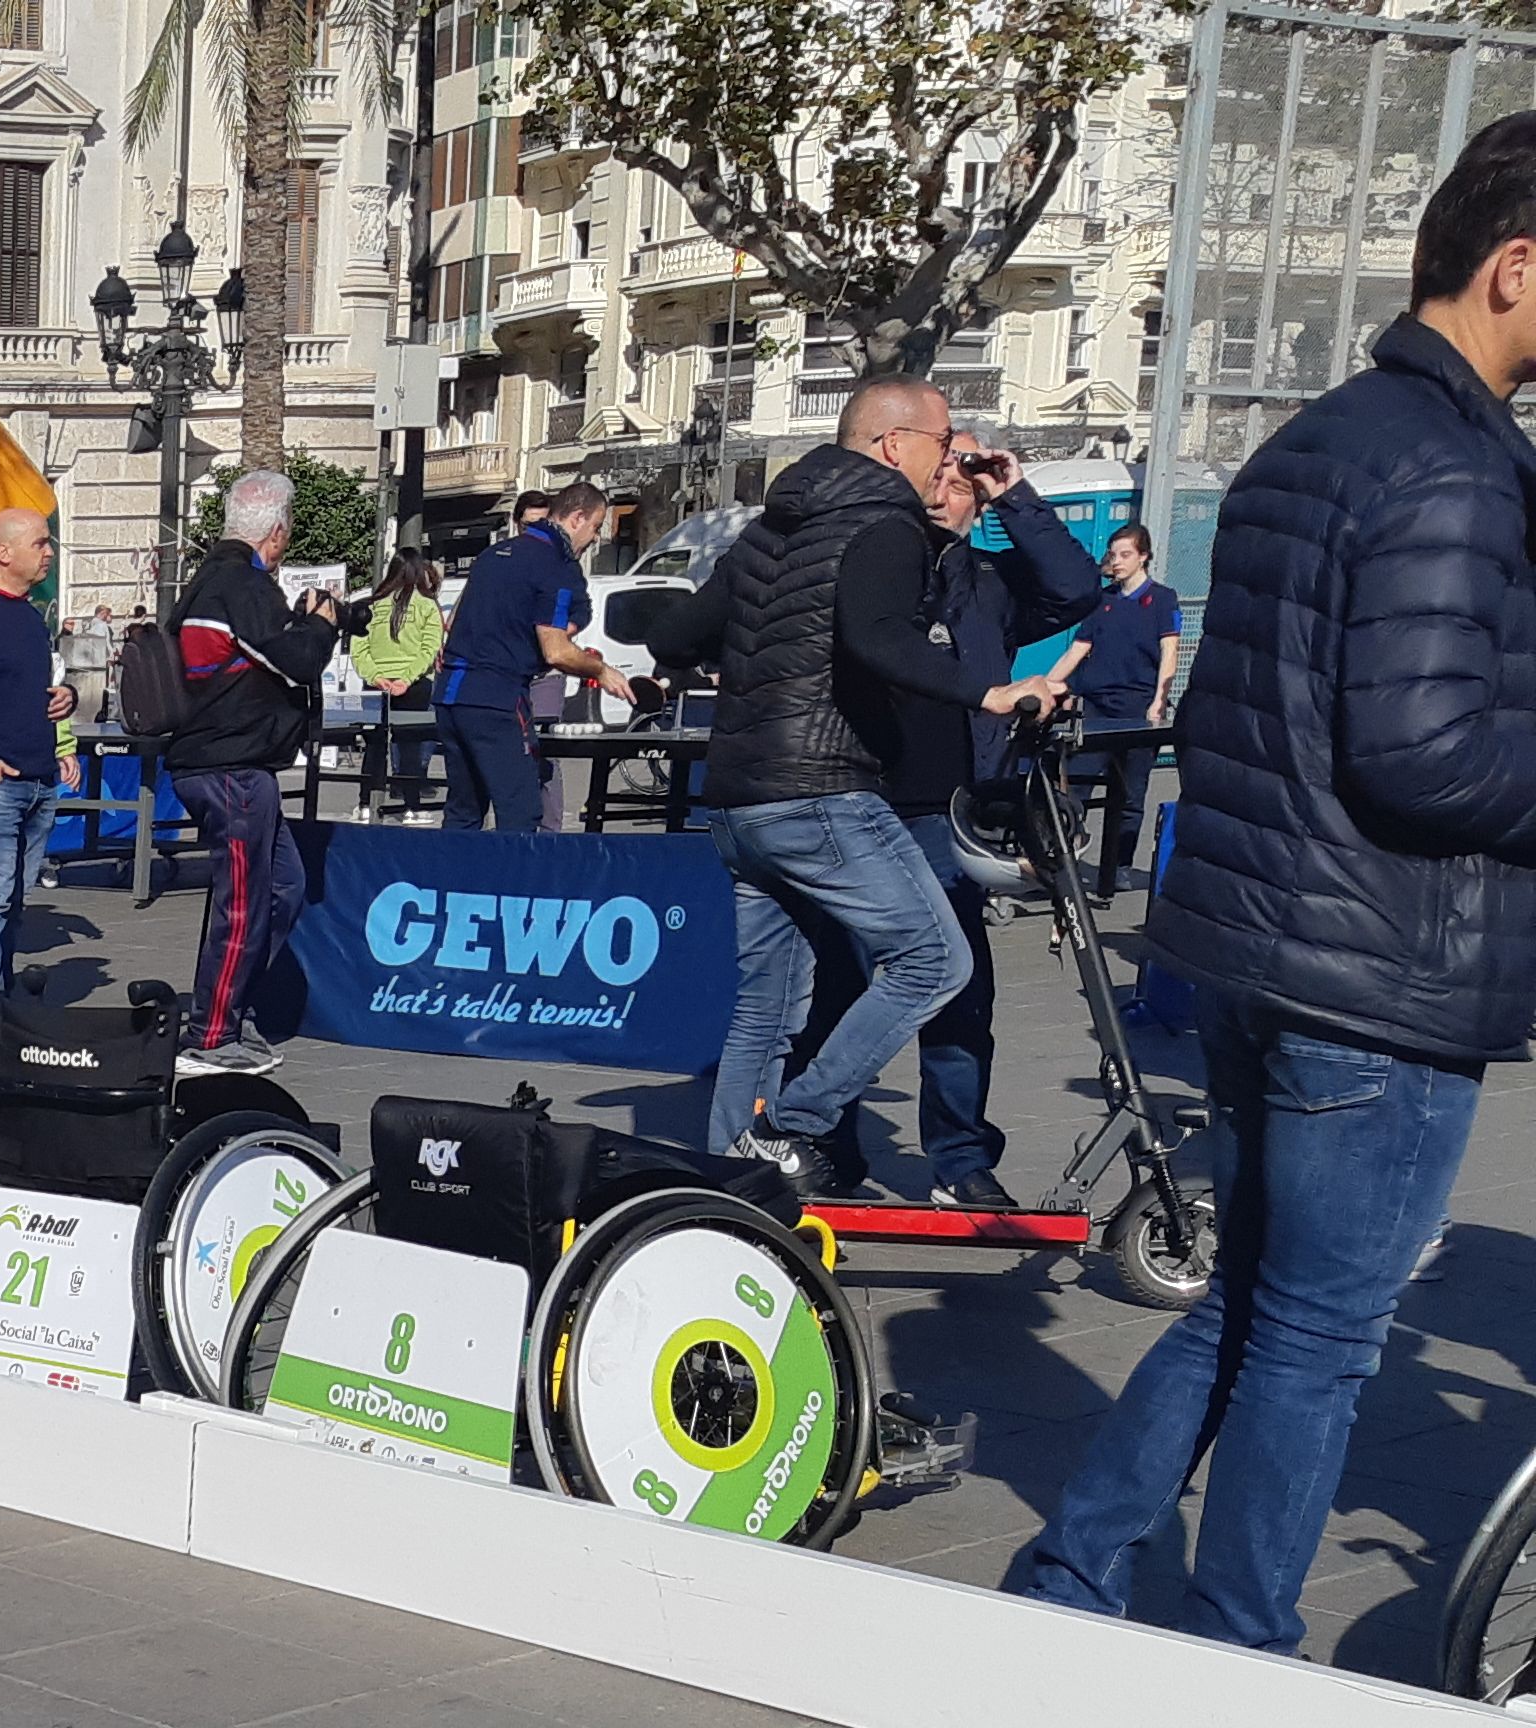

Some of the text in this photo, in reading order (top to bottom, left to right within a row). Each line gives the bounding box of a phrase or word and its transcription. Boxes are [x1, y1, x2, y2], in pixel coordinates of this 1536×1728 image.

[365, 881, 660, 986] GEWO
[369, 975, 636, 1030] that's table tennis!
[272, 1168, 307, 1218] 21
[410, 1180, 472, 1197] CLUB SPORT
[0, 1250, 51, 1308] 21
[734, 1273, 776, 1319] 8
[0, 1320, 36, 1342] Social
[385, 1312, 416, 1375] 8
[328, 1381, 448, 1433] ORTOPRONO
[745, 1390, 823, 1534] ORTOPRONO
[632, 1468, 678, 1516] 8
